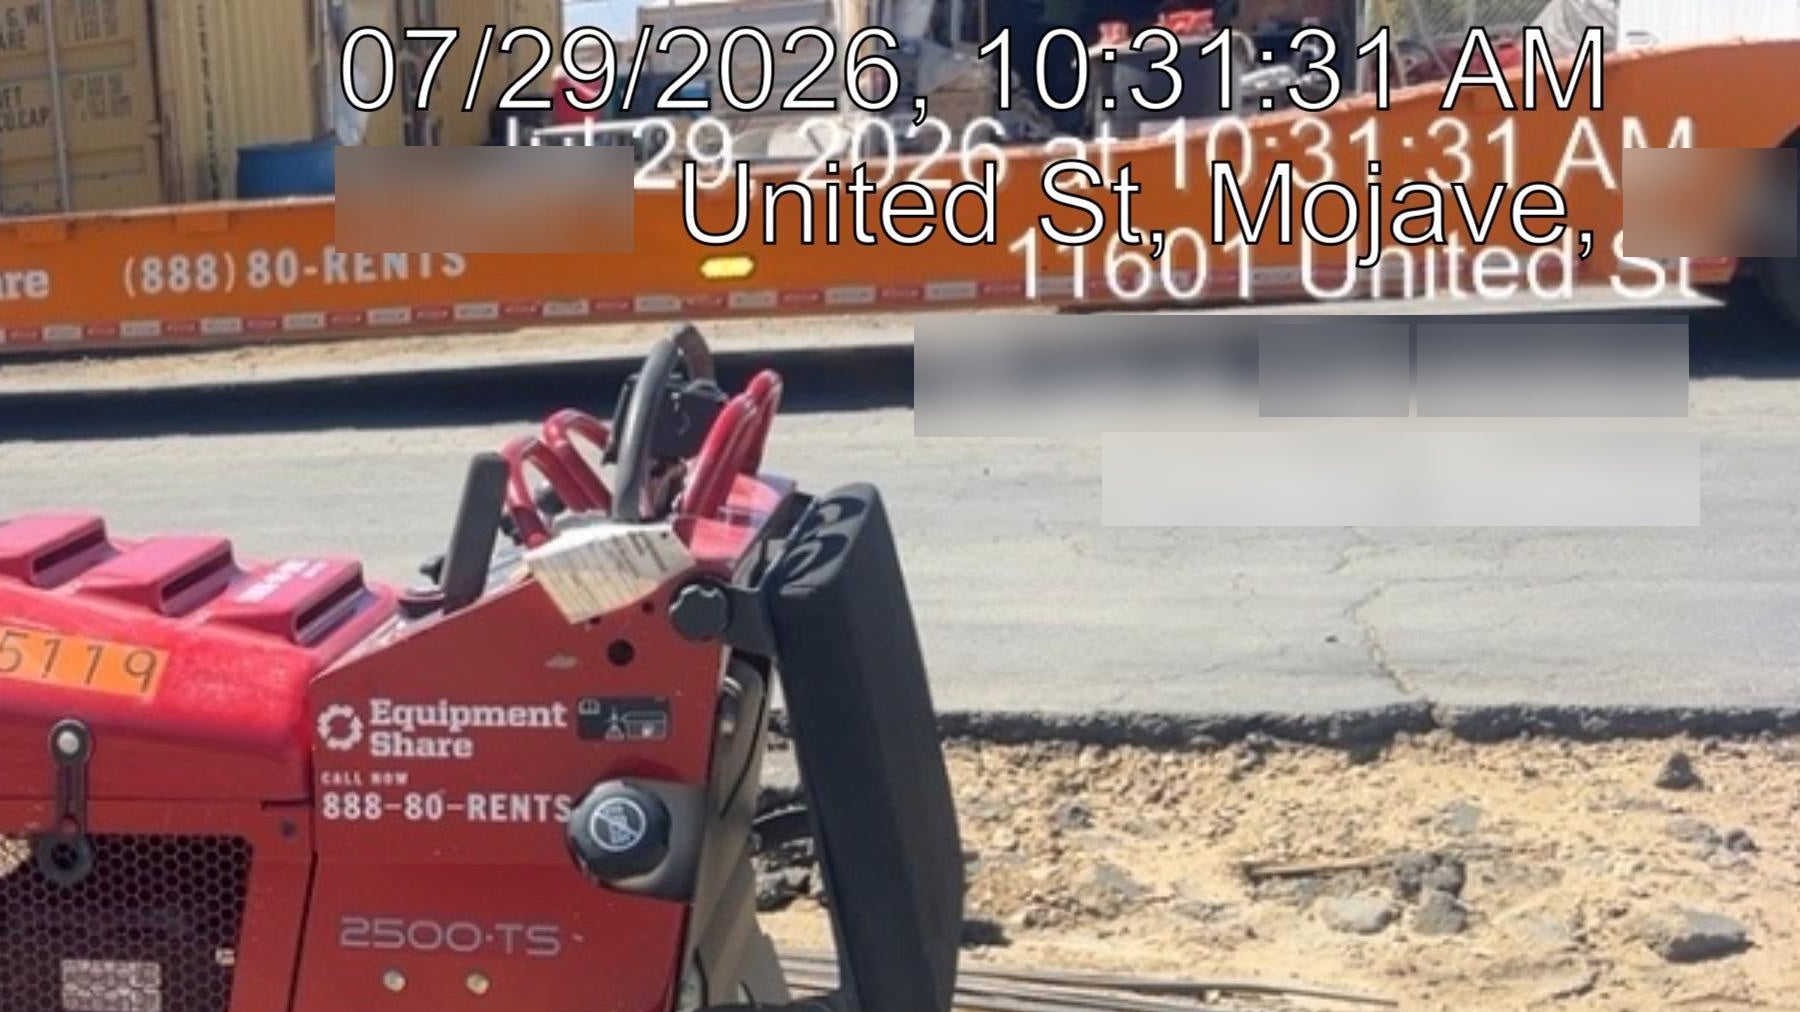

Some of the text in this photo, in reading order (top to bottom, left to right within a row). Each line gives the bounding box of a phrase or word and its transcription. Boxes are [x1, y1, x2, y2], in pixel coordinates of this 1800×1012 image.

[370, 698, 568, 733] Equipment
[370, 731, 474, 759] Share
[321, 772, 409, 785] CALL NOW
[322, 791, 572, 823] 888-80-RENTS
